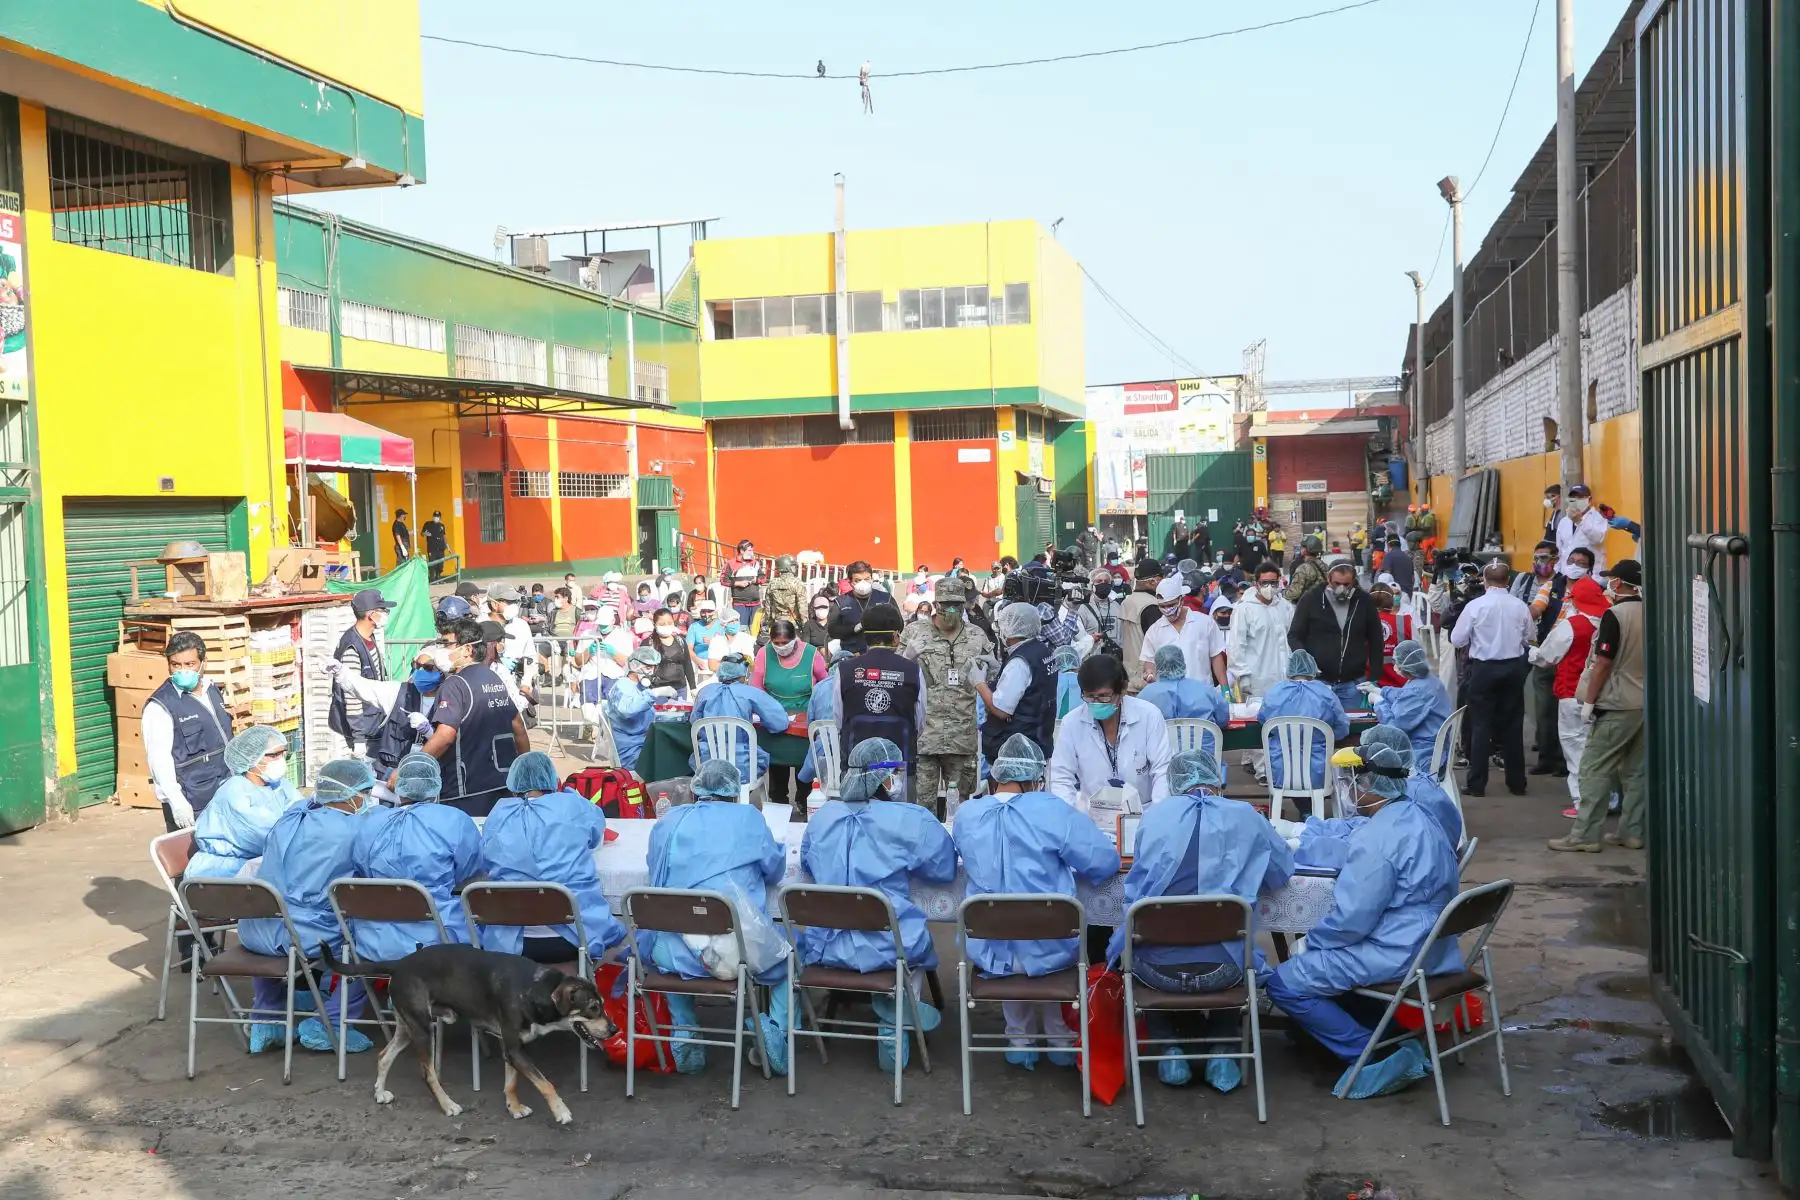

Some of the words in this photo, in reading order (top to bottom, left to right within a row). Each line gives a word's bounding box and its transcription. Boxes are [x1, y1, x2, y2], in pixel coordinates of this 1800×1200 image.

[1180, 382, 1200, 391] UHU
[1001, 432, 1010, 442] S
[1256, 446, 1264, 455] S
[495, 697, 509, 707] Salud
